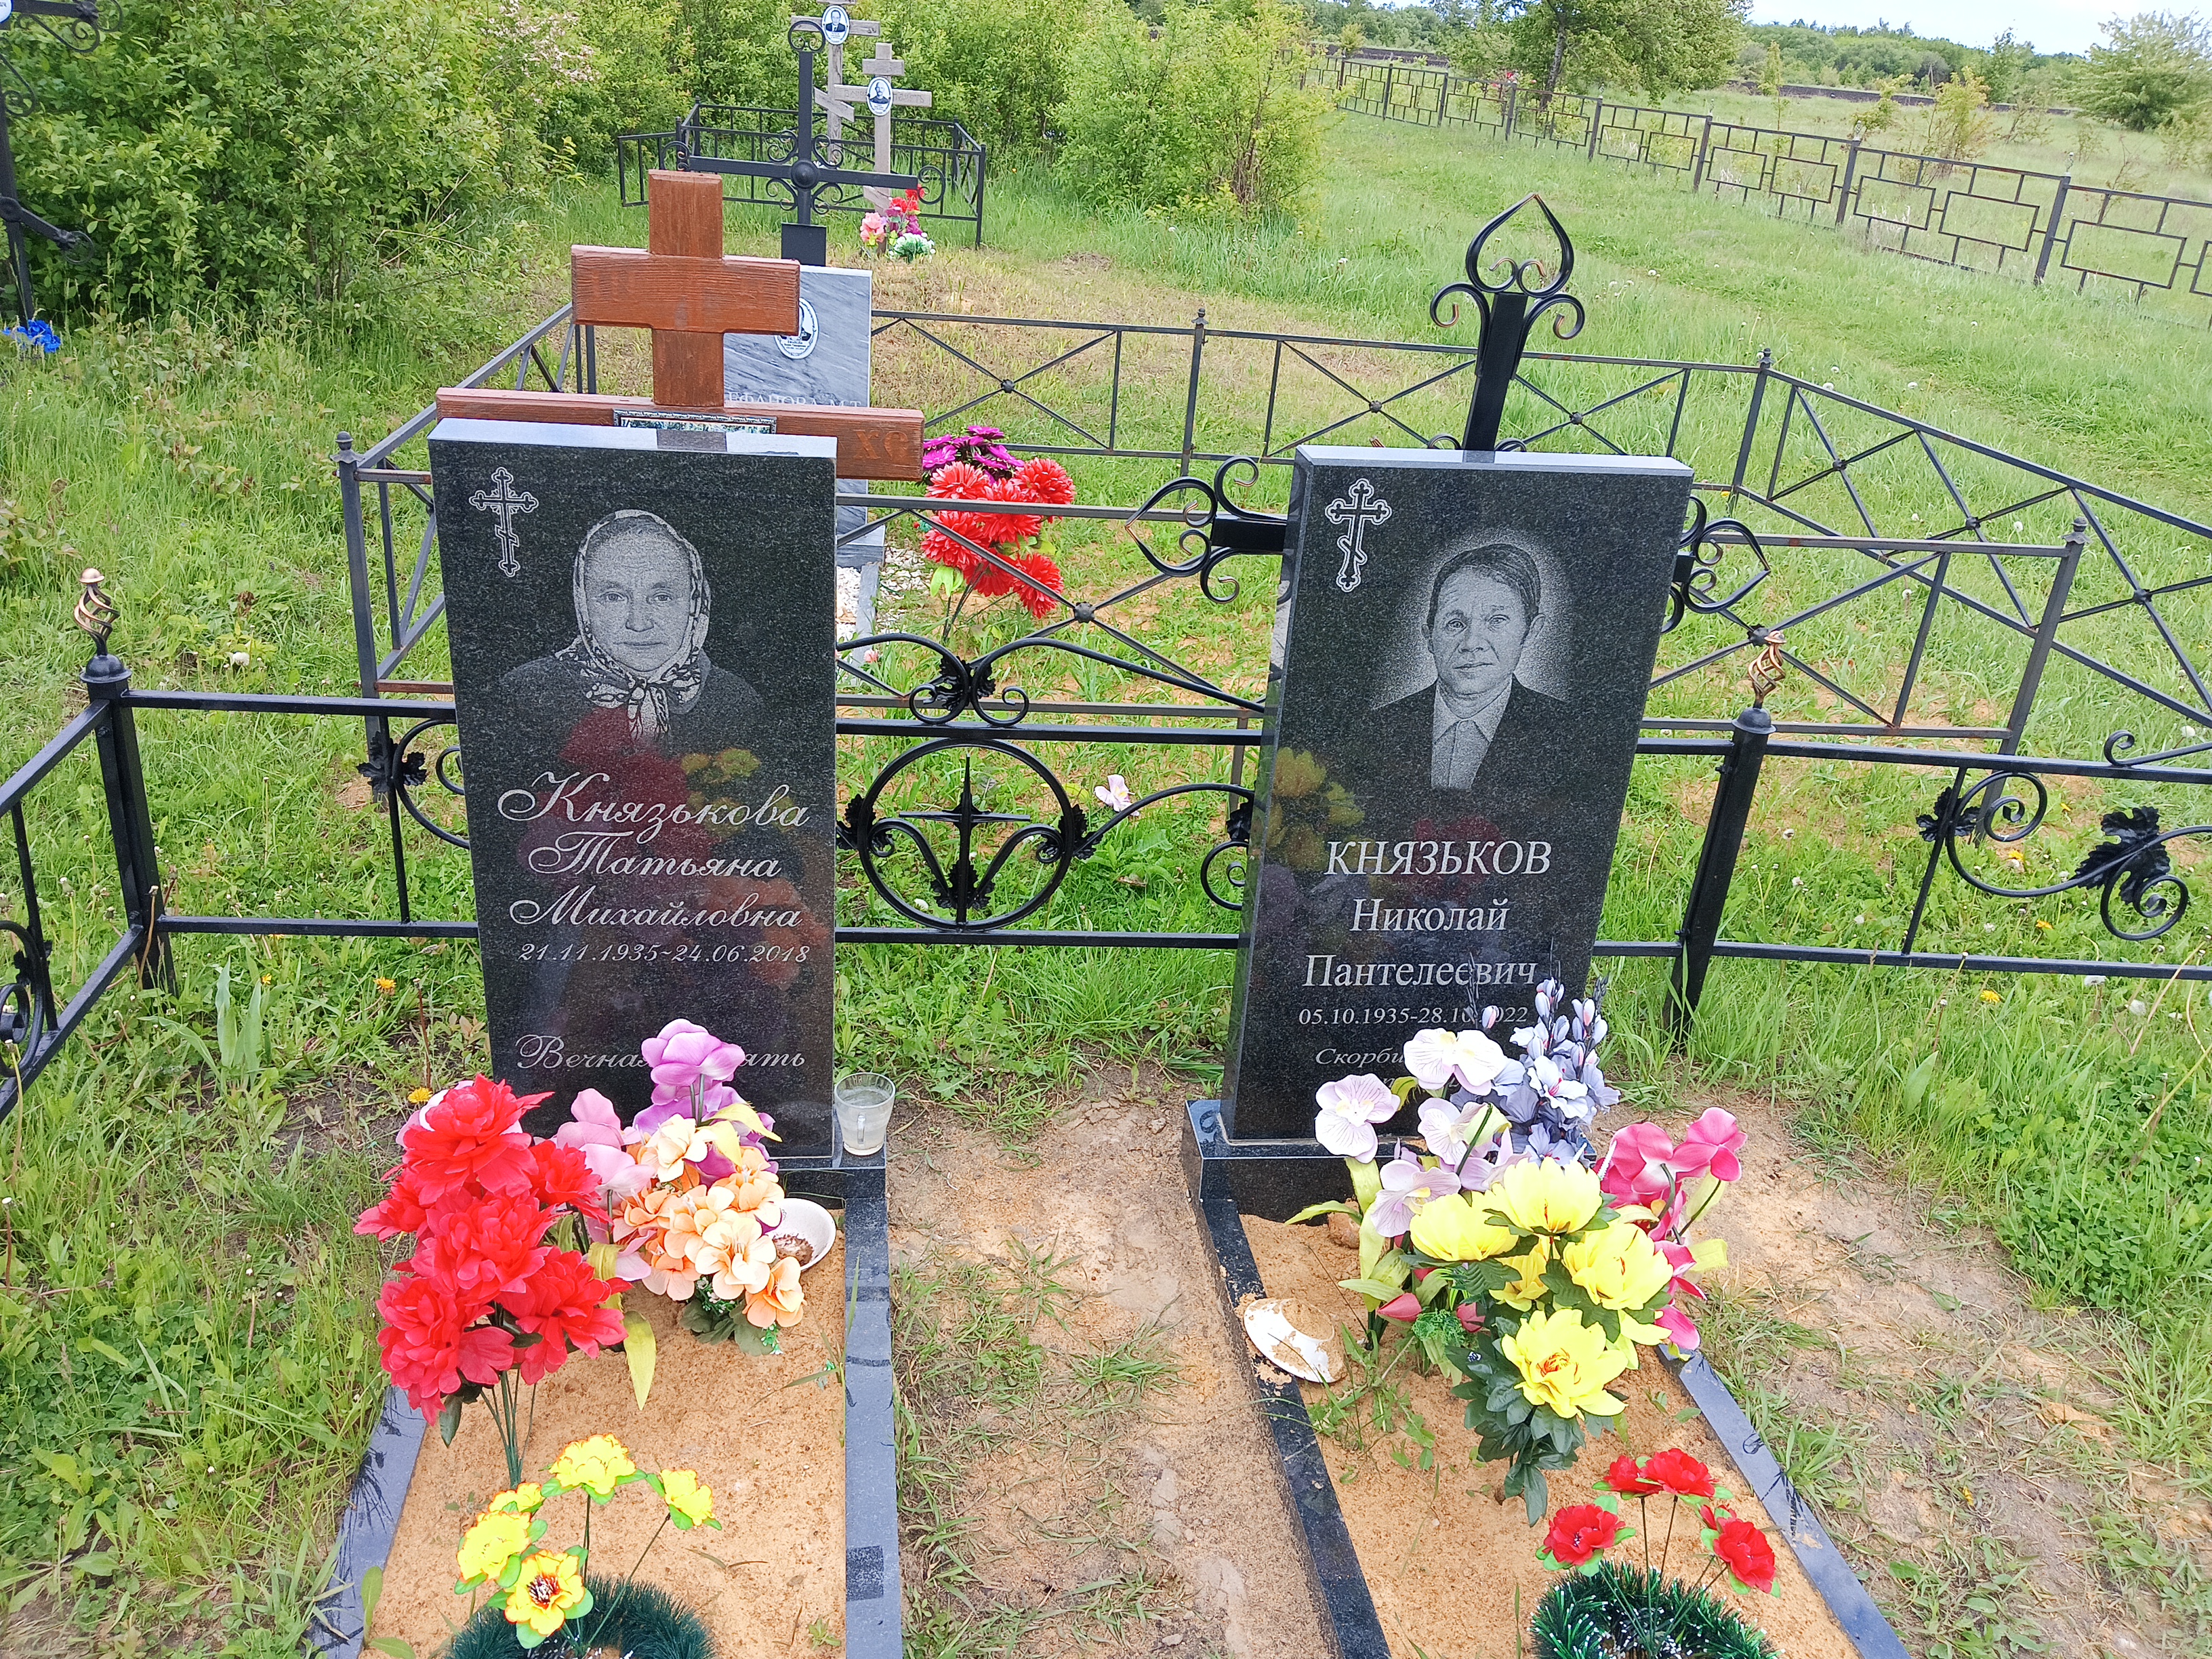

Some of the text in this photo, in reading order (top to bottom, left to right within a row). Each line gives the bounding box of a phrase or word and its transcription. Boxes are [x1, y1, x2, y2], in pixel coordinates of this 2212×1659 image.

[497, 771, 812, 844] Князькова
[527, 830, 782, 878] Татьяна
[1324, 840, 1553, 876] КНЯЗЬКОВ
[509, 884, 803, 927] Михайловна
[1349, 898, 1511, 933] Николай
[1301, 954, 1539, 987] Пантелеевич
